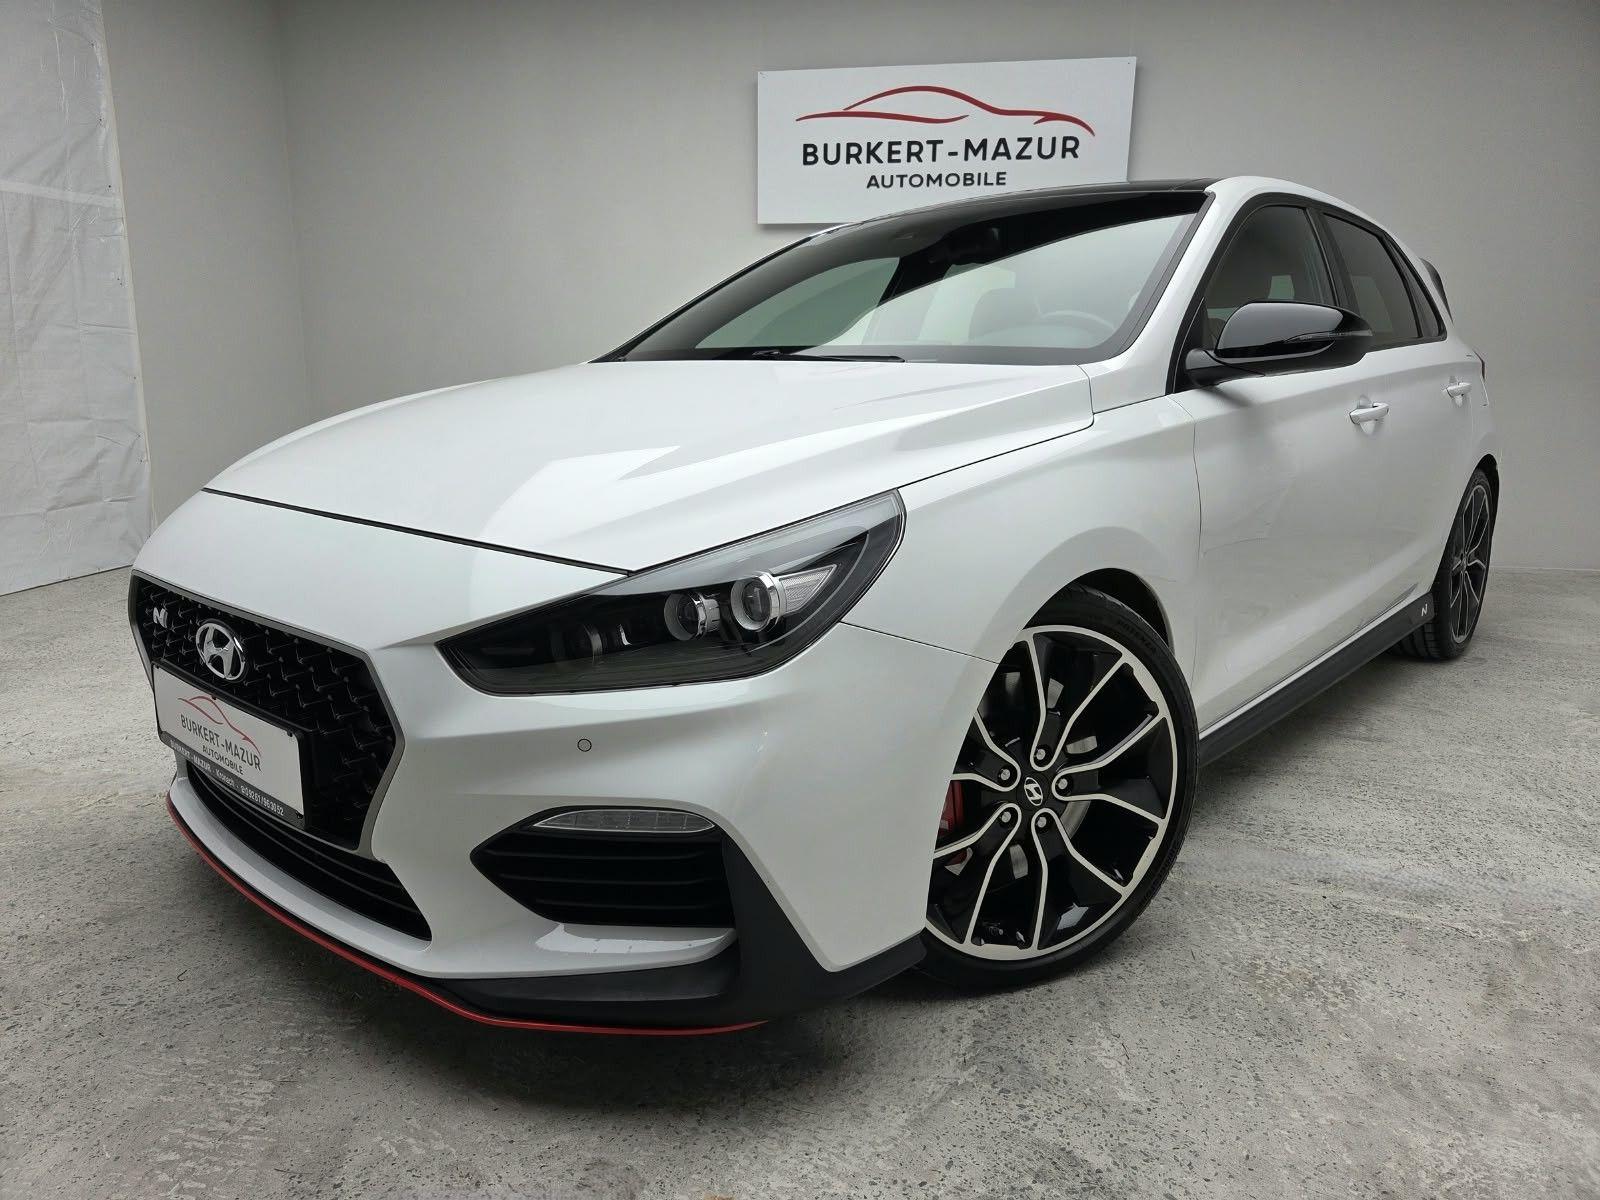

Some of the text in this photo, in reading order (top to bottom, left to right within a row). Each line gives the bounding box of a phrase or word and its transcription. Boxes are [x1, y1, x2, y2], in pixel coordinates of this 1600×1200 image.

[802, 135, 1081, 166] BURKERT-MAZUR
[866, 171, 1007, 189] AUTOMOBILE
[180, 713, 262, 772] BURKERT-MAZUR
[202, 744, 244, 775] AUTOMOBILE
